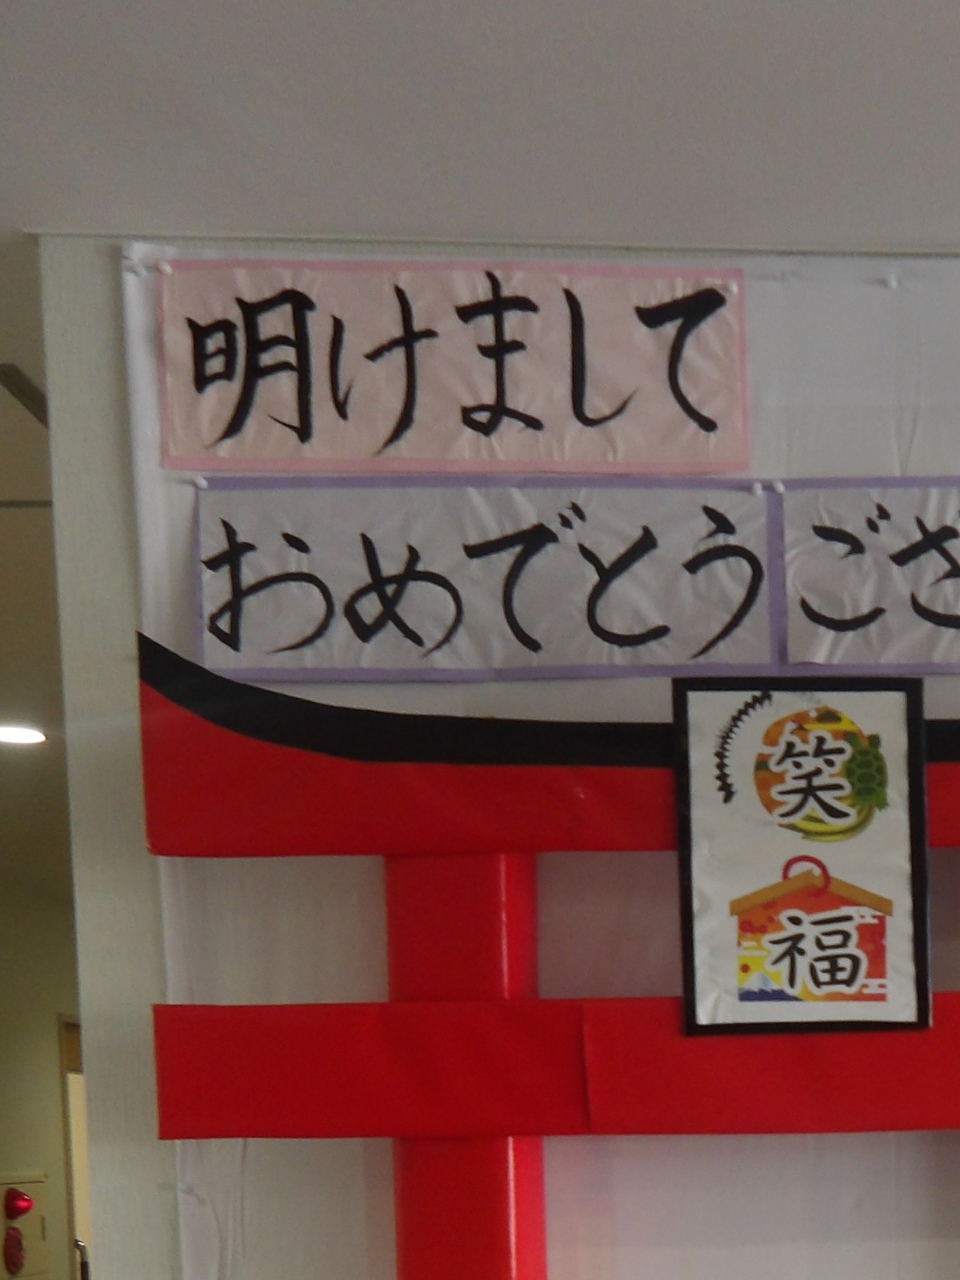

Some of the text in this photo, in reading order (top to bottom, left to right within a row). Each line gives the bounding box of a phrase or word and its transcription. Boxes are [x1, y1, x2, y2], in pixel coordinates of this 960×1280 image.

[186, 270, 727, 454] 明けまして
[202, 502, 764, 659] おめでとう
[774, 735, 851, 820] 笑
[768, 915, 862, 990] 福
